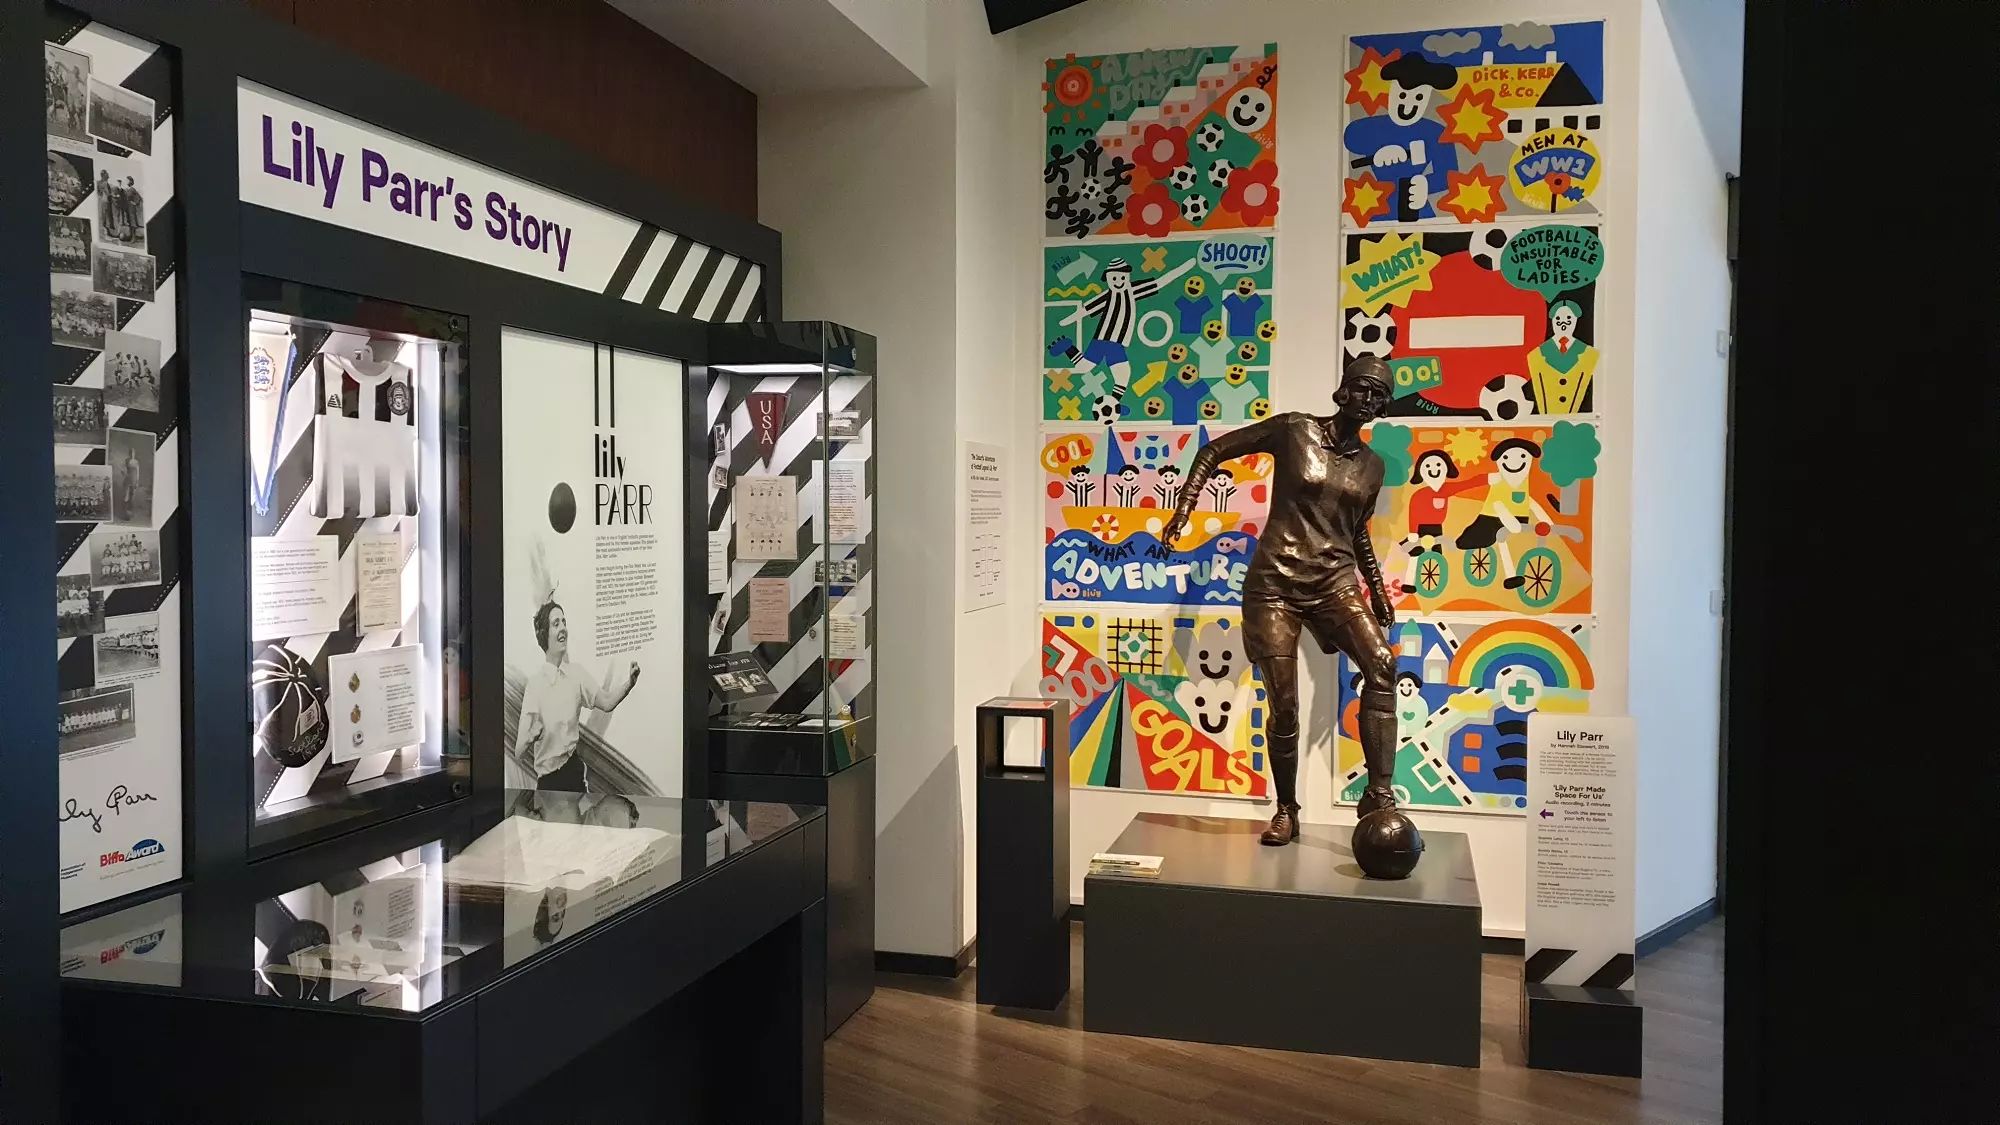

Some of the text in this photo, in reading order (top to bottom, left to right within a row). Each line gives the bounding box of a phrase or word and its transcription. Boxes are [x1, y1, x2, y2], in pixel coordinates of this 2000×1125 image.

[1517, 66, 1555, 80] KERR
[1499, 83, 1512, 98] &
[1521, 133, 1588, 156] MEN AT
[1520, 156, 1586, 179] WW1
[261, 114, 572, 272] Lily Parr's Story
[1510, 229, 1582, 253] FOOTBALL
[1201, 242, 1268, 266] SHOOT!
[1351, 240, 1425, 292] WHAT!
[1535, 258, 1562, 270] FOR
[759, 400, 774, 445] USA
[1045, 439, 1092, 468] COOL
[595, 483, 653, 525] PARR
[1088, 541, 1136, 563] WHAT
[1052, 549, 1249, 595] ADVENTURE
[1130, 699, 1252, 796] GOALS
[1557, 730, 1604, 743] Lily Parr
[106, 784, 158, 816] Parr
[1554, 791, 1577, 799] Space
